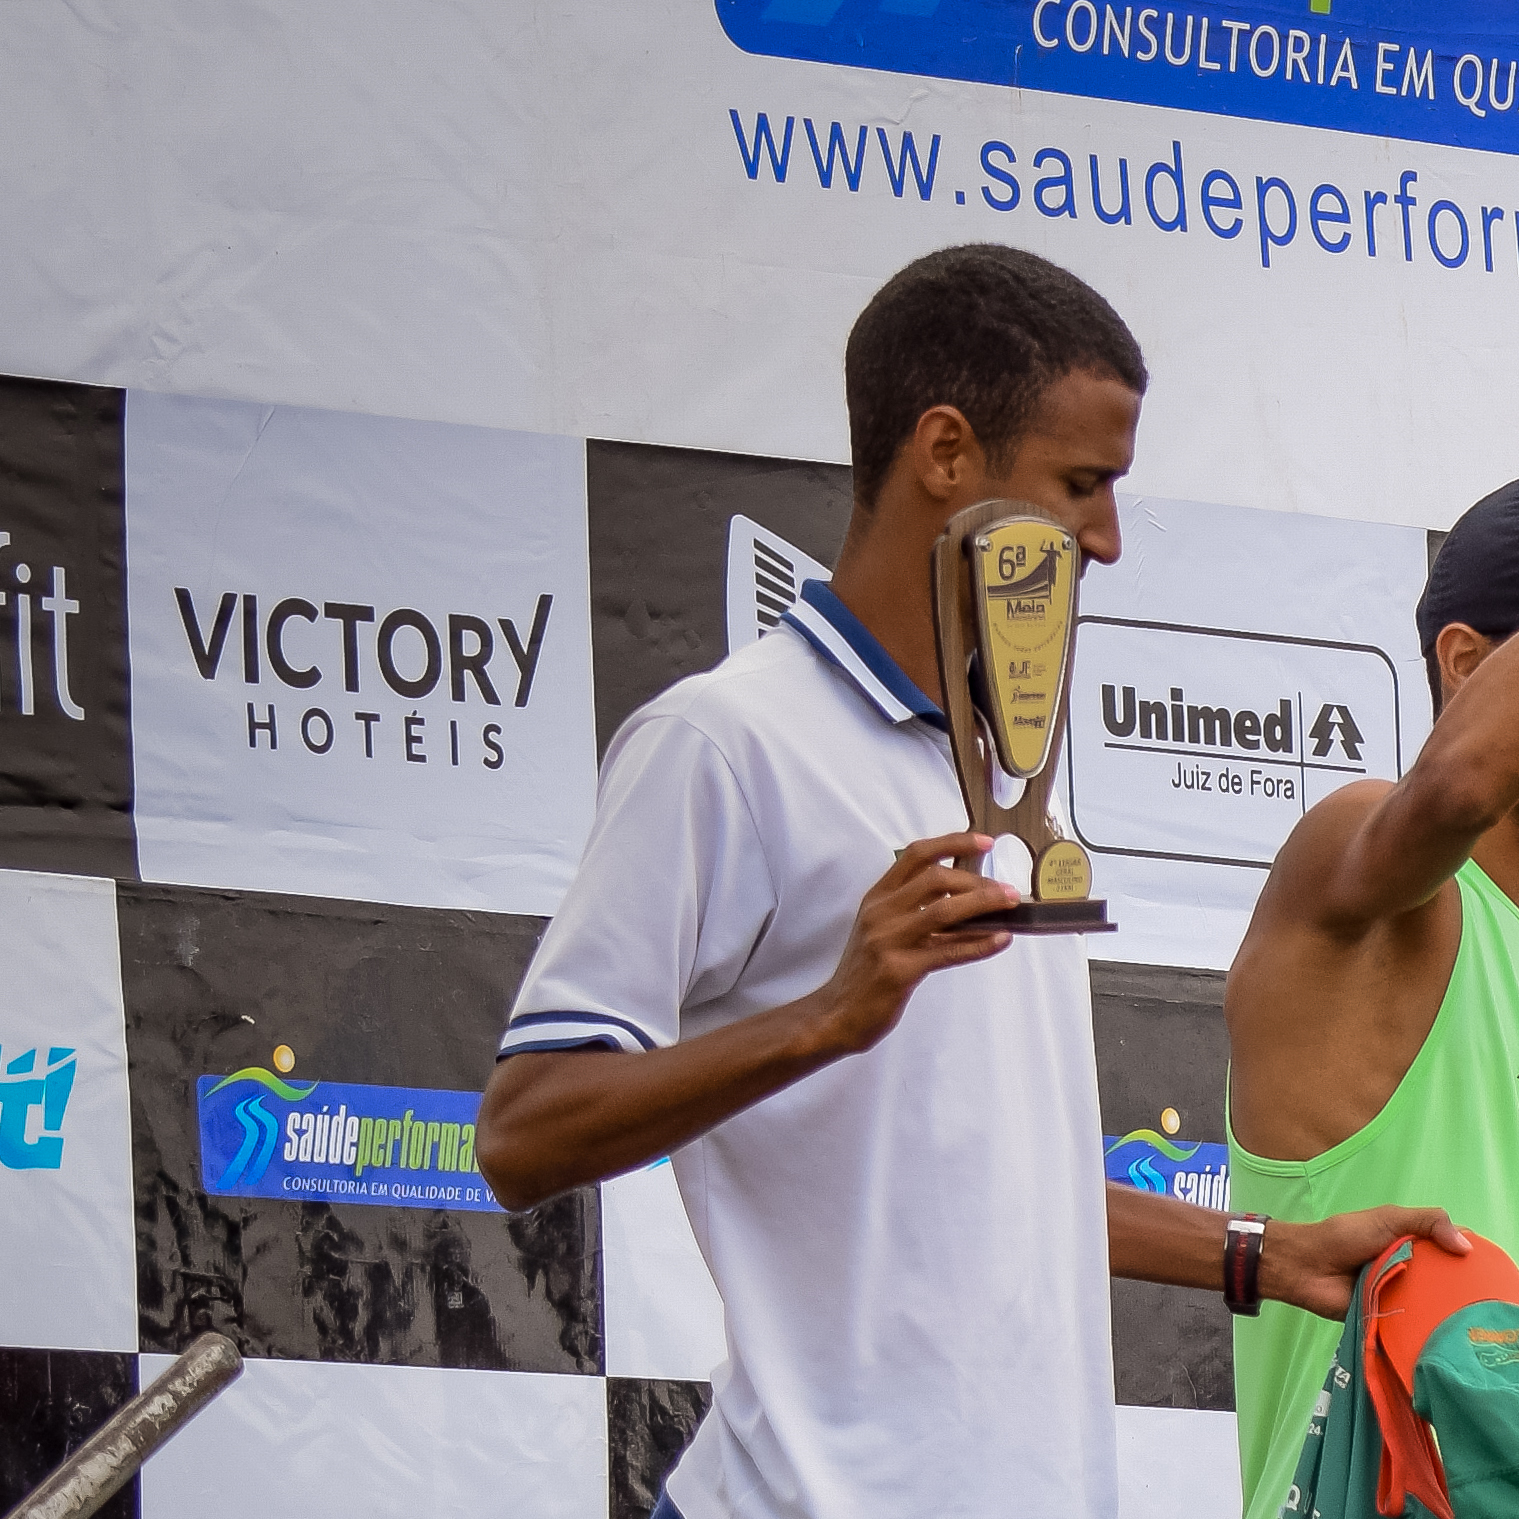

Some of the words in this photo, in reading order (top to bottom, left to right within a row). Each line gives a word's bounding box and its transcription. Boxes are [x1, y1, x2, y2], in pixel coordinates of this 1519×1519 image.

[1033, 0, 1358, 90] CONSULTORIA
[1376, 42, 1435, 100] EM
[997, 545, 1027, 581] 6ª
[0, 532, 85, 721] it
[174, 586, 554, 708] VICTORY
[247, 703, 506, 770] HOTÉIS
[1102, 684, 1293, 754] Unimed
[1172, 763, 1212, 792] Juiz
[1219, 769, 1243, 795] de
[1251, 772, 1295, 801] Fora
[283, 1104, 481, 1178] saúdeperforma
[283, 1176, 367, 1196] CONSULTORIA
[371, 1183, 388, 1196] EM
[392, 1183, 462, 1202] QUALIDADE
[466, 1188, 481, 1201] DE
